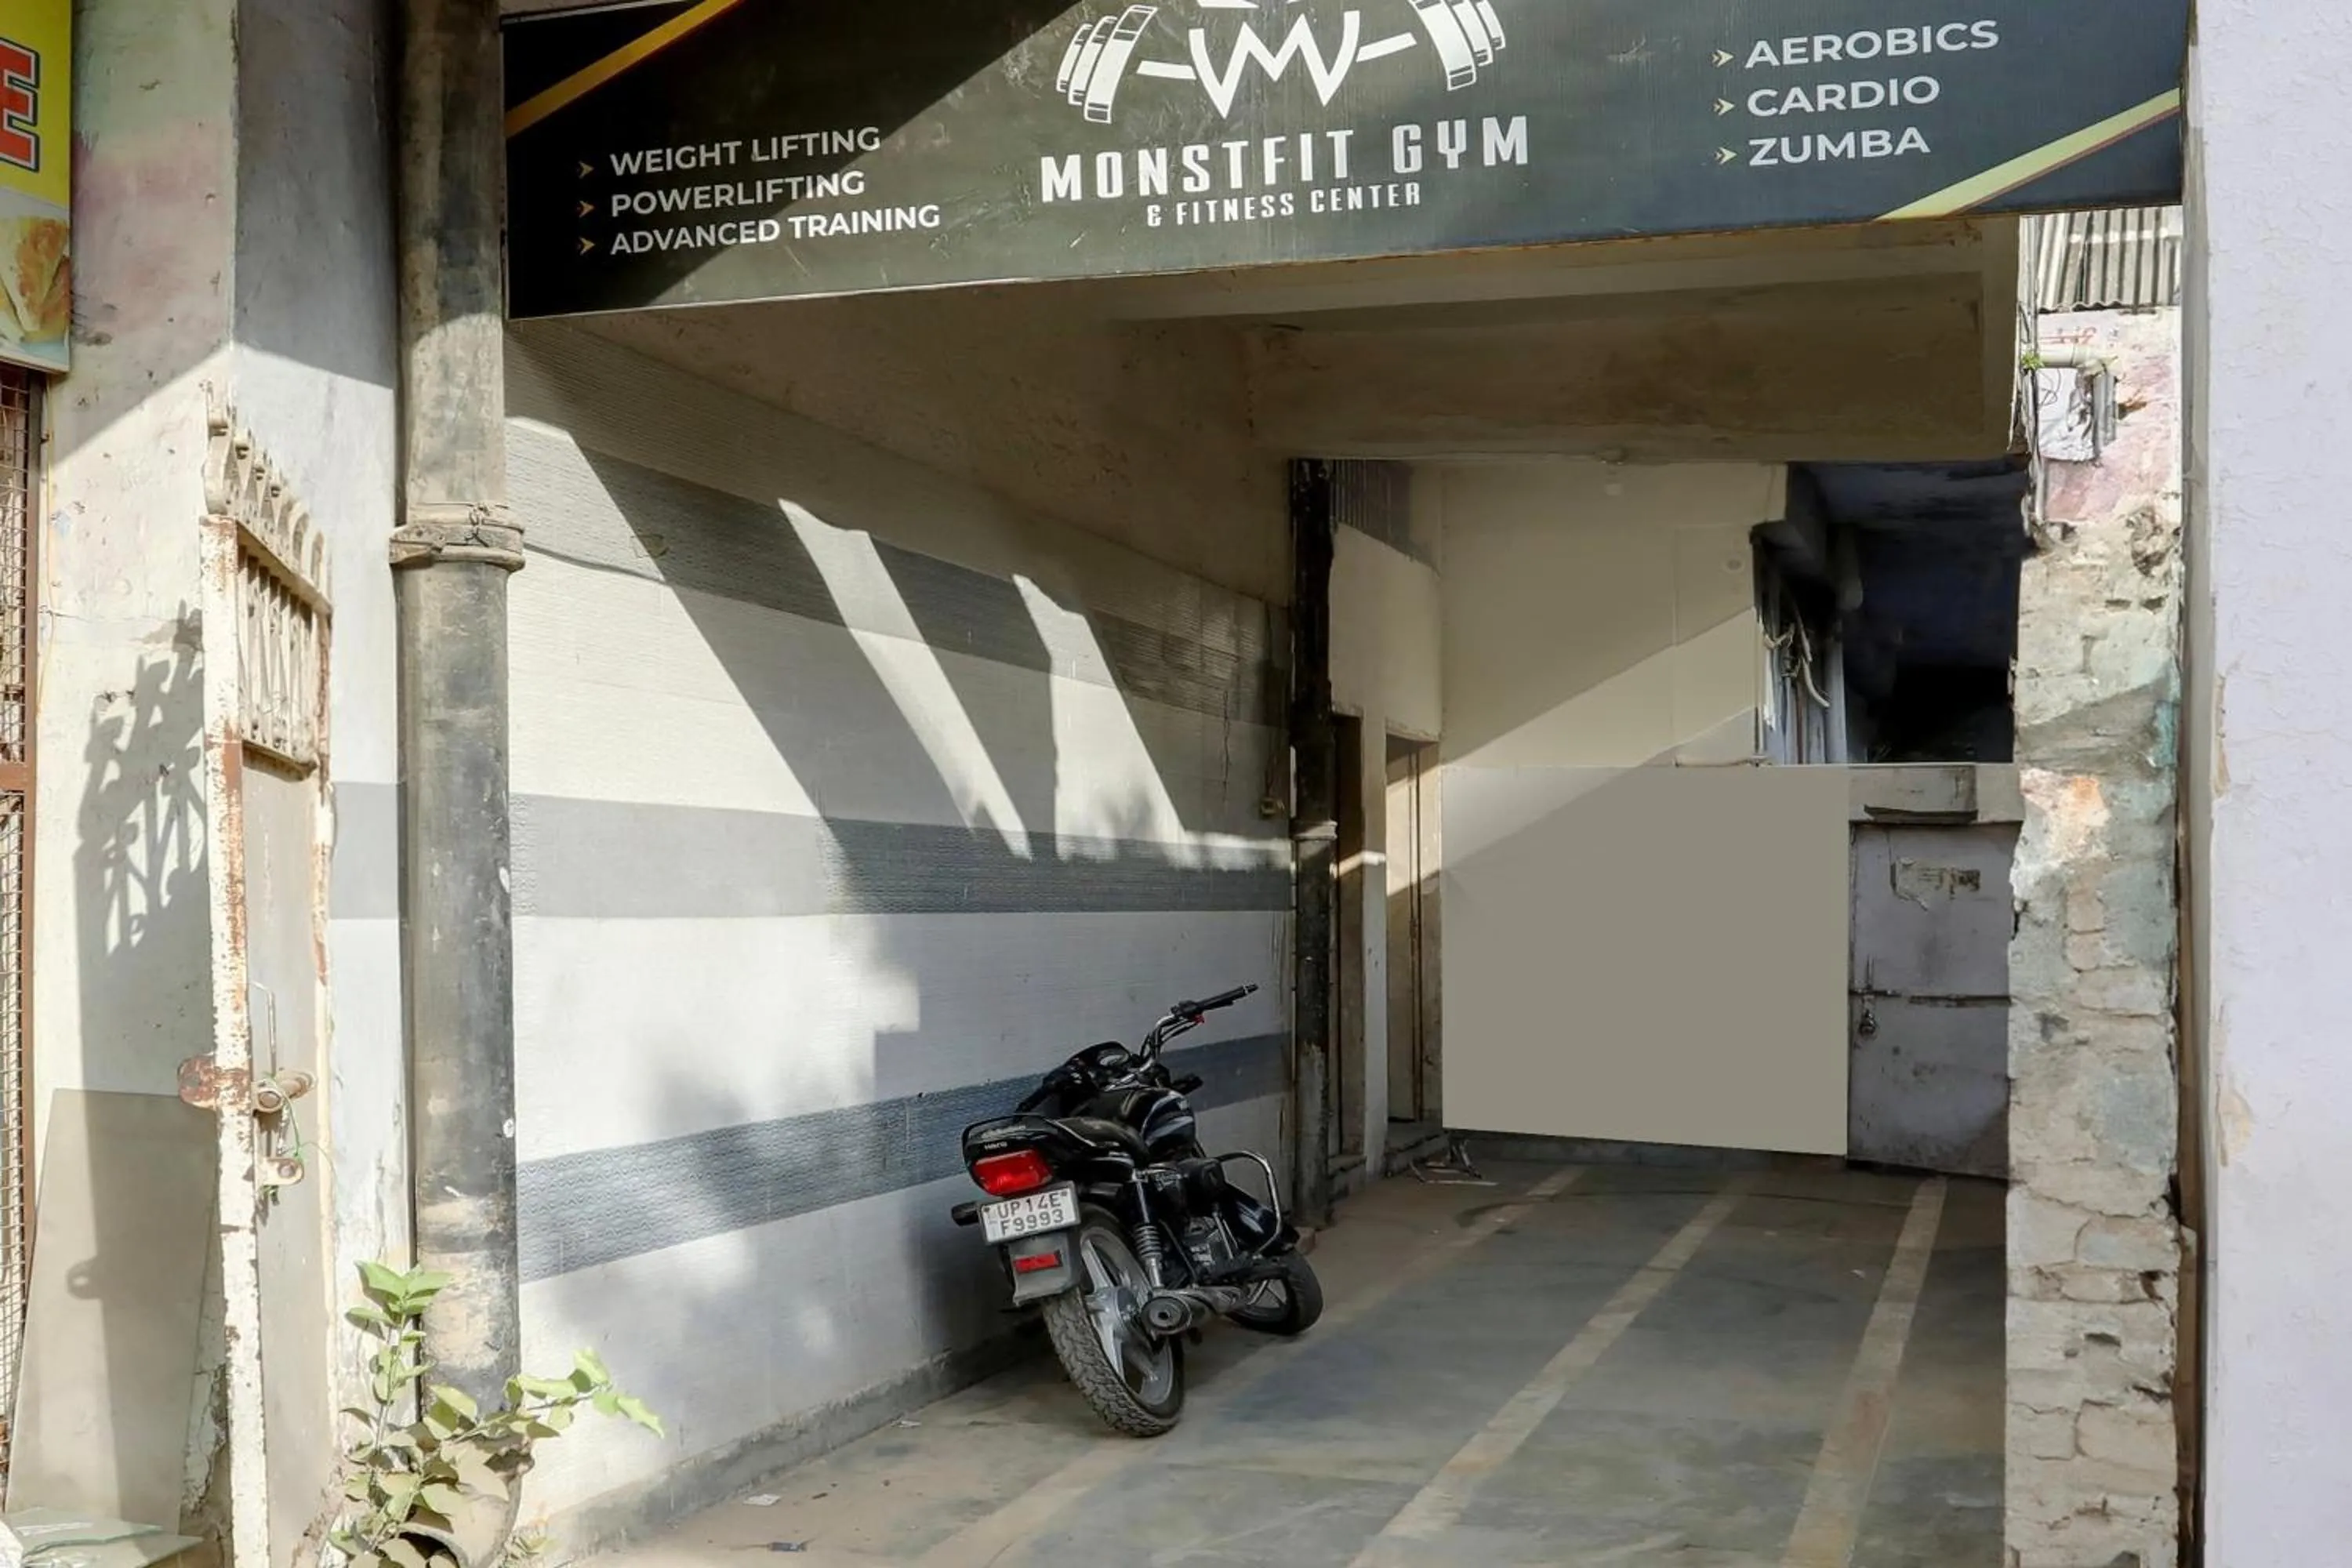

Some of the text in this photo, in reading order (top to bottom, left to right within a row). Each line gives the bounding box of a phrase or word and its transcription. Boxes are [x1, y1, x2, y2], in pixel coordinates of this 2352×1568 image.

[1744, 20, 1999, 69] AEROBICS
[1747, 75, 1940, 117] CARDIO
[609, 126, 881, 176] WEIGHT LIFTING
[1040, 115, 1528, 202] MONSTFIT GYM
[1748, 126, 1931, 166] ZUMBA
[611, 170, 866, 218] POWERLIFTING
[1147, 182, 1421, 227] & FITNESS CENTER
[610, 204, 941, 256] ADVANCED TRAINING
